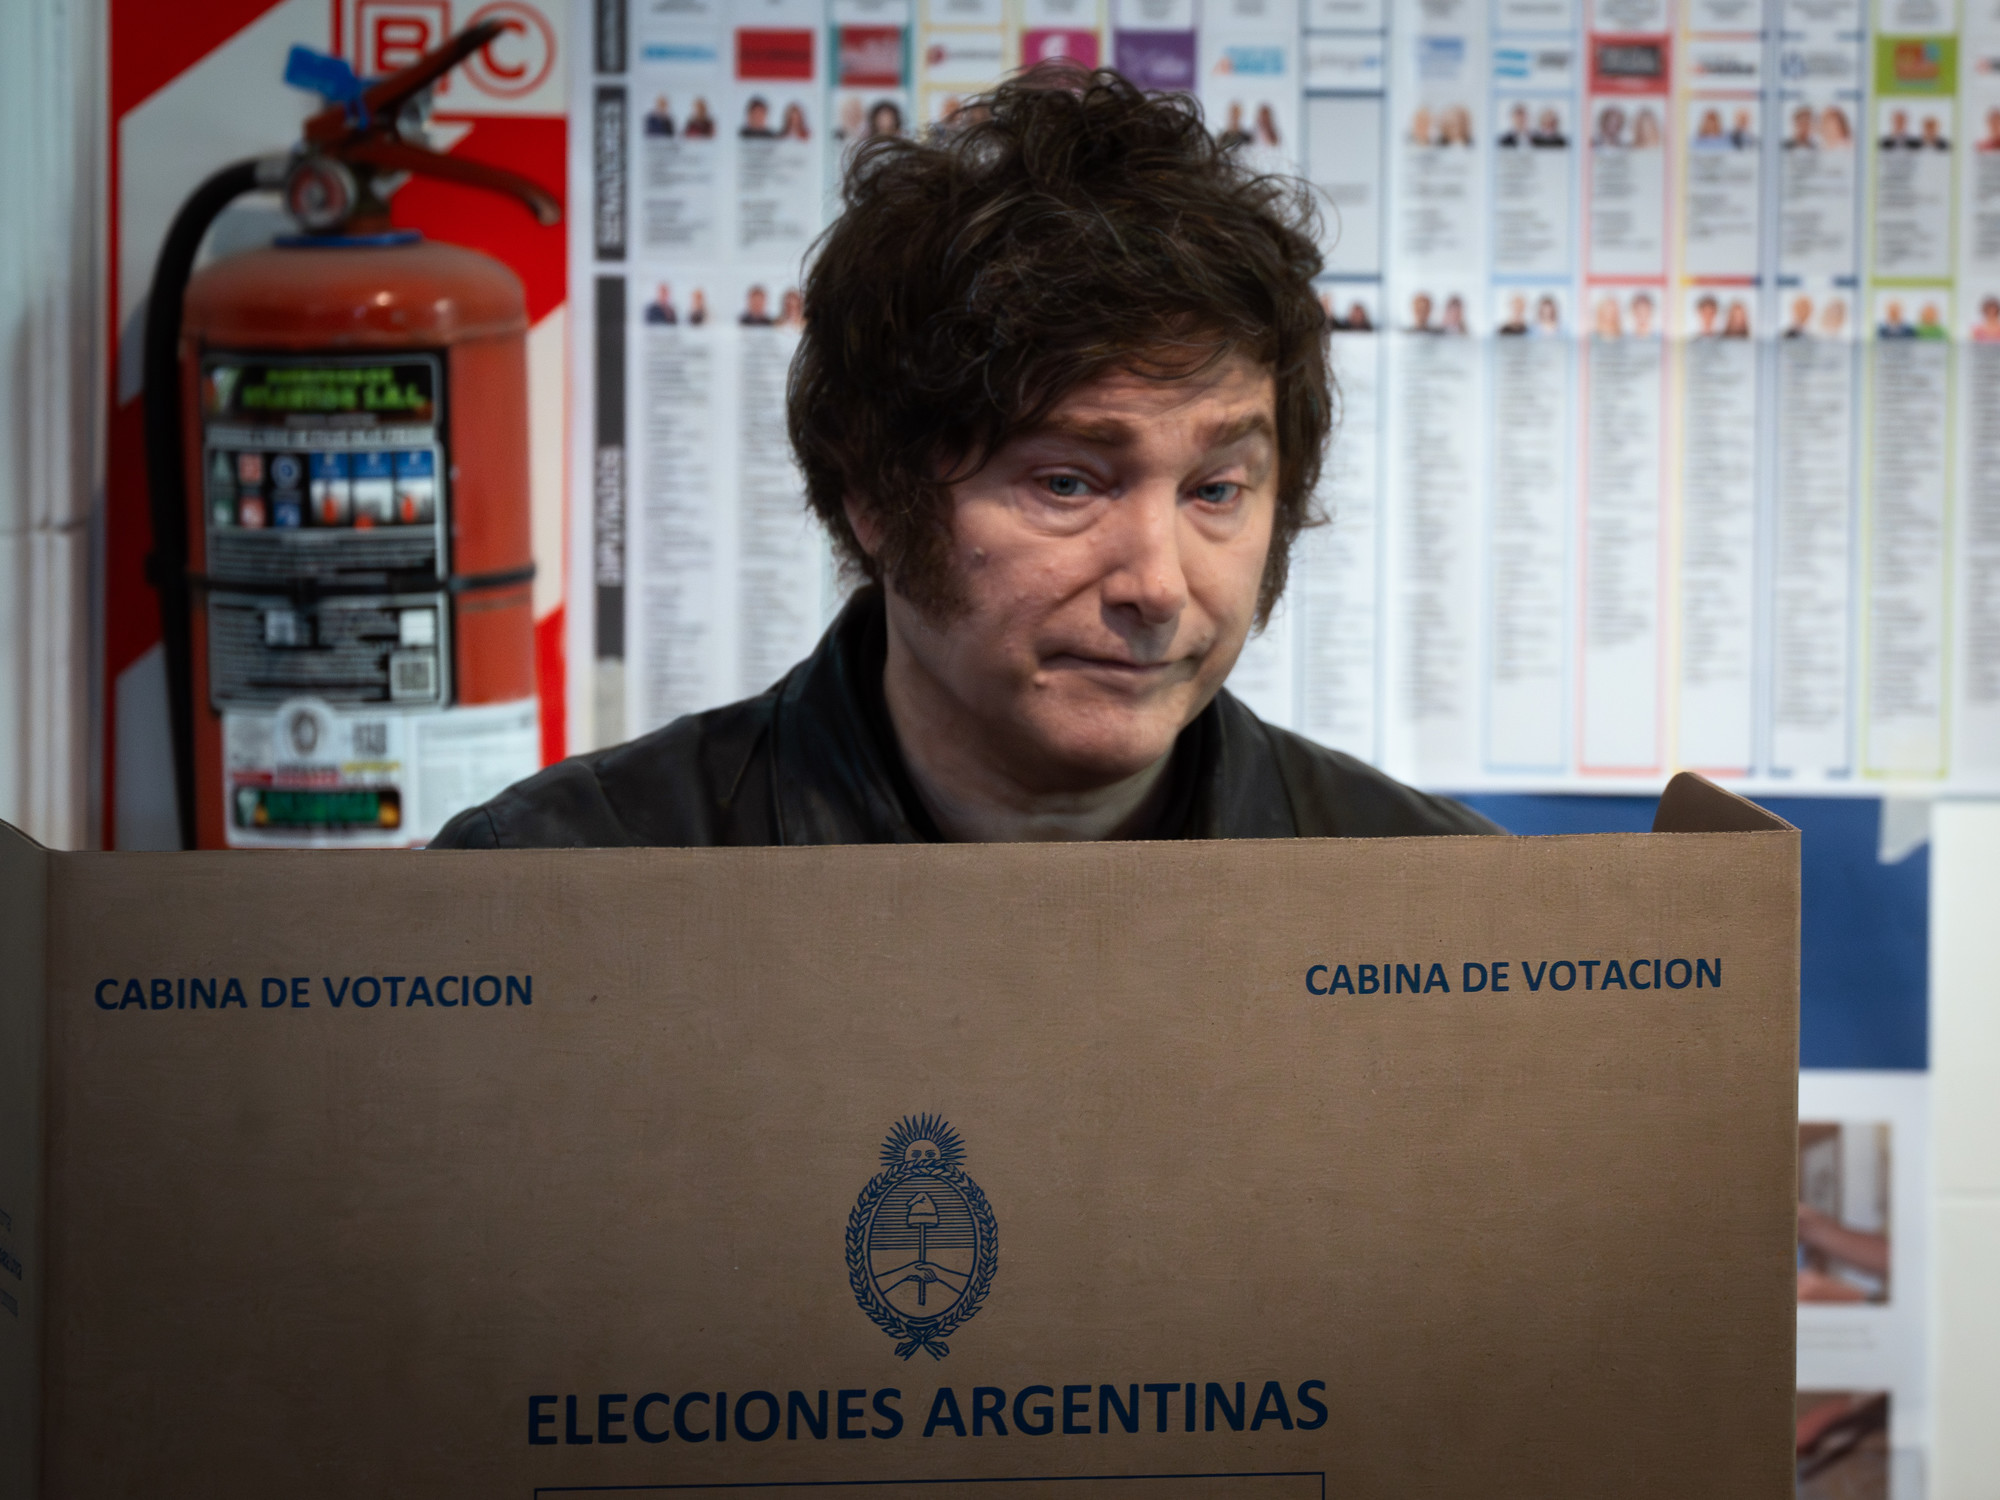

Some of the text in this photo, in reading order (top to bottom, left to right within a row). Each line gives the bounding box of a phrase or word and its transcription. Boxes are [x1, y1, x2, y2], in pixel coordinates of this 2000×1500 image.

[374, 17, 430, 75] B
[480, 18, 527, 80] C
[95, 975, 532, 1011] CABINA DE VOTACION
[1306, 958, 1722, 996] CABINA DE VOTACION
[529, 1379, 1329, 1445] ELECCIONES ARGENTINAS
